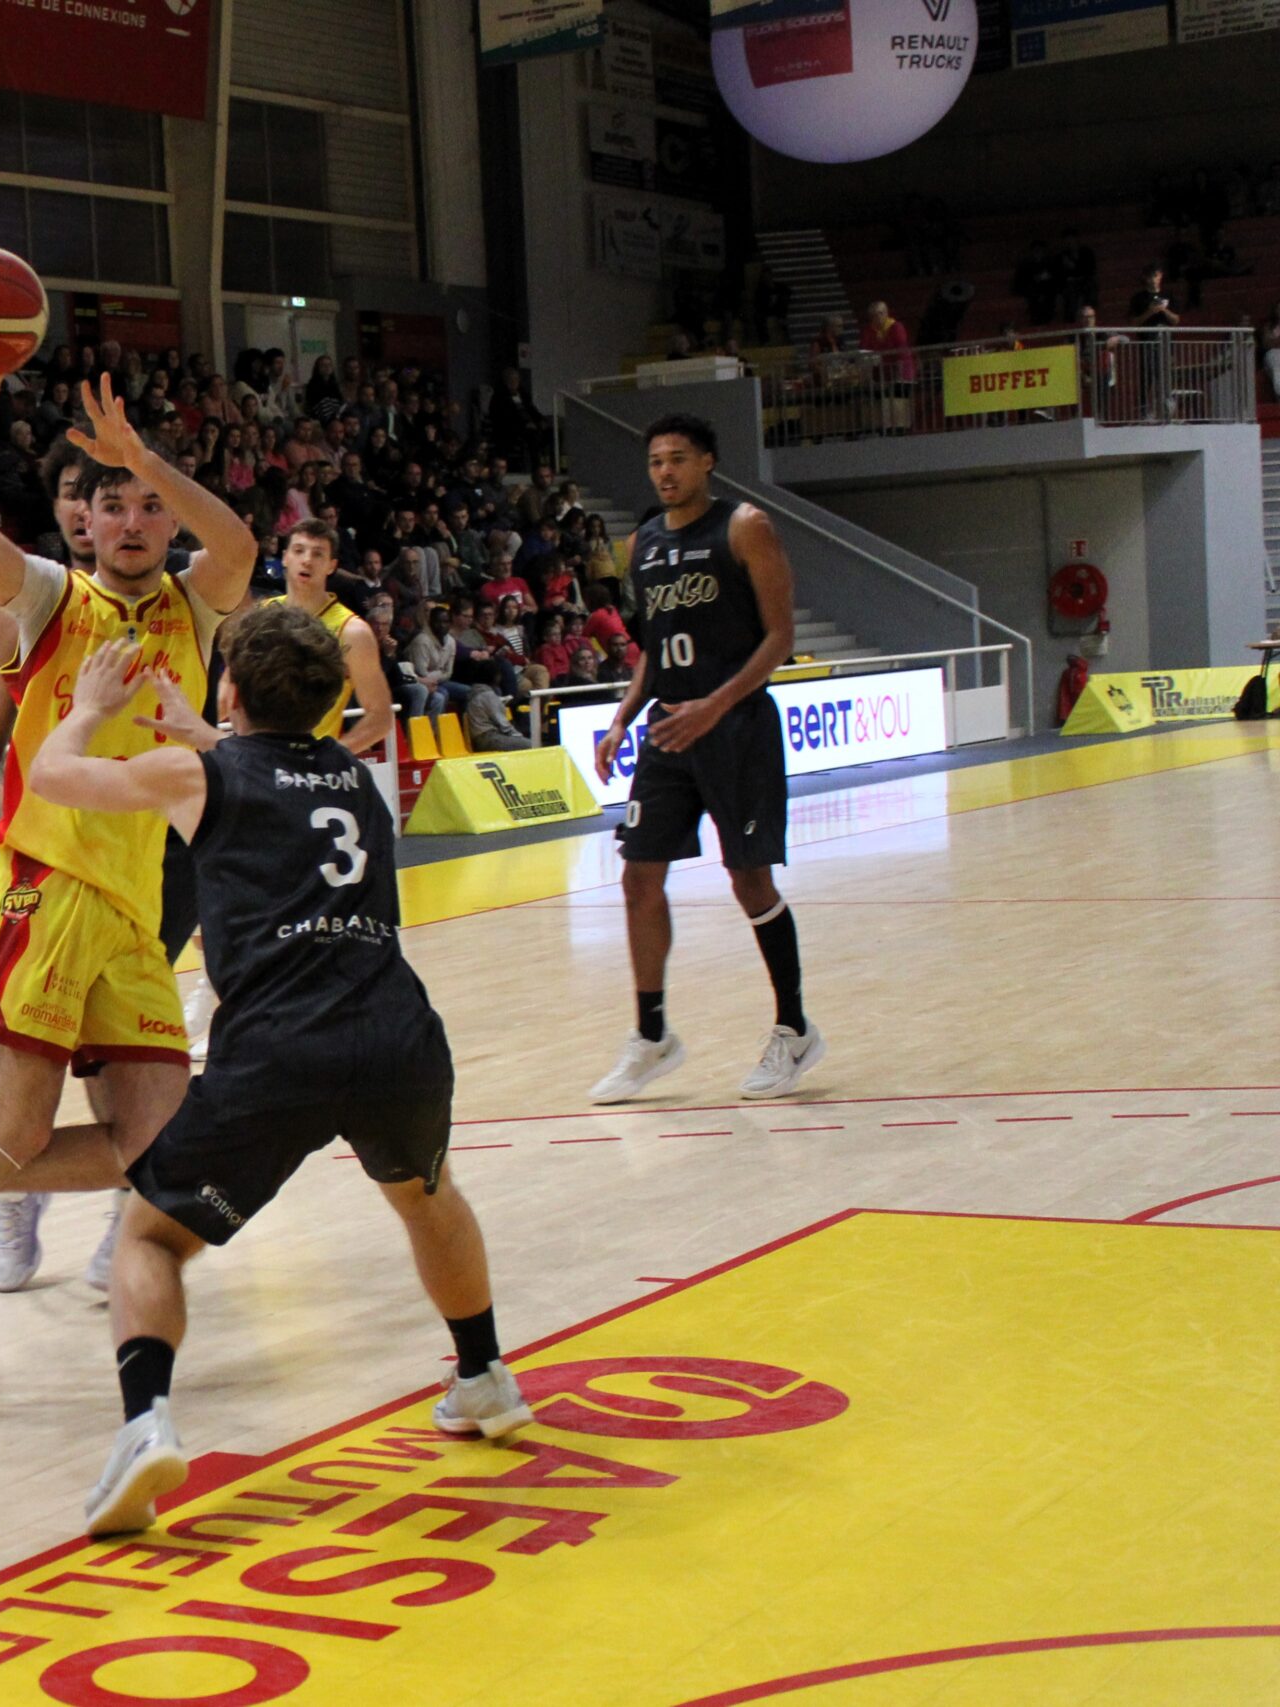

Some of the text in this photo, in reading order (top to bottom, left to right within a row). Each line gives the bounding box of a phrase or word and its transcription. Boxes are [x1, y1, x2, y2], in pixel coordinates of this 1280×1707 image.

[65, 0, 146, 28] CONNEXIONS
[891, 34, 969, 51] RENAULT
[896, 54, 962, 70] TRUCKS
[969, 367, 1049, 394] BUFFET
[661, 632, 695, 670] 10
[275, 766, 359, 792] BARON
[310, 806, 368, 888] 3
